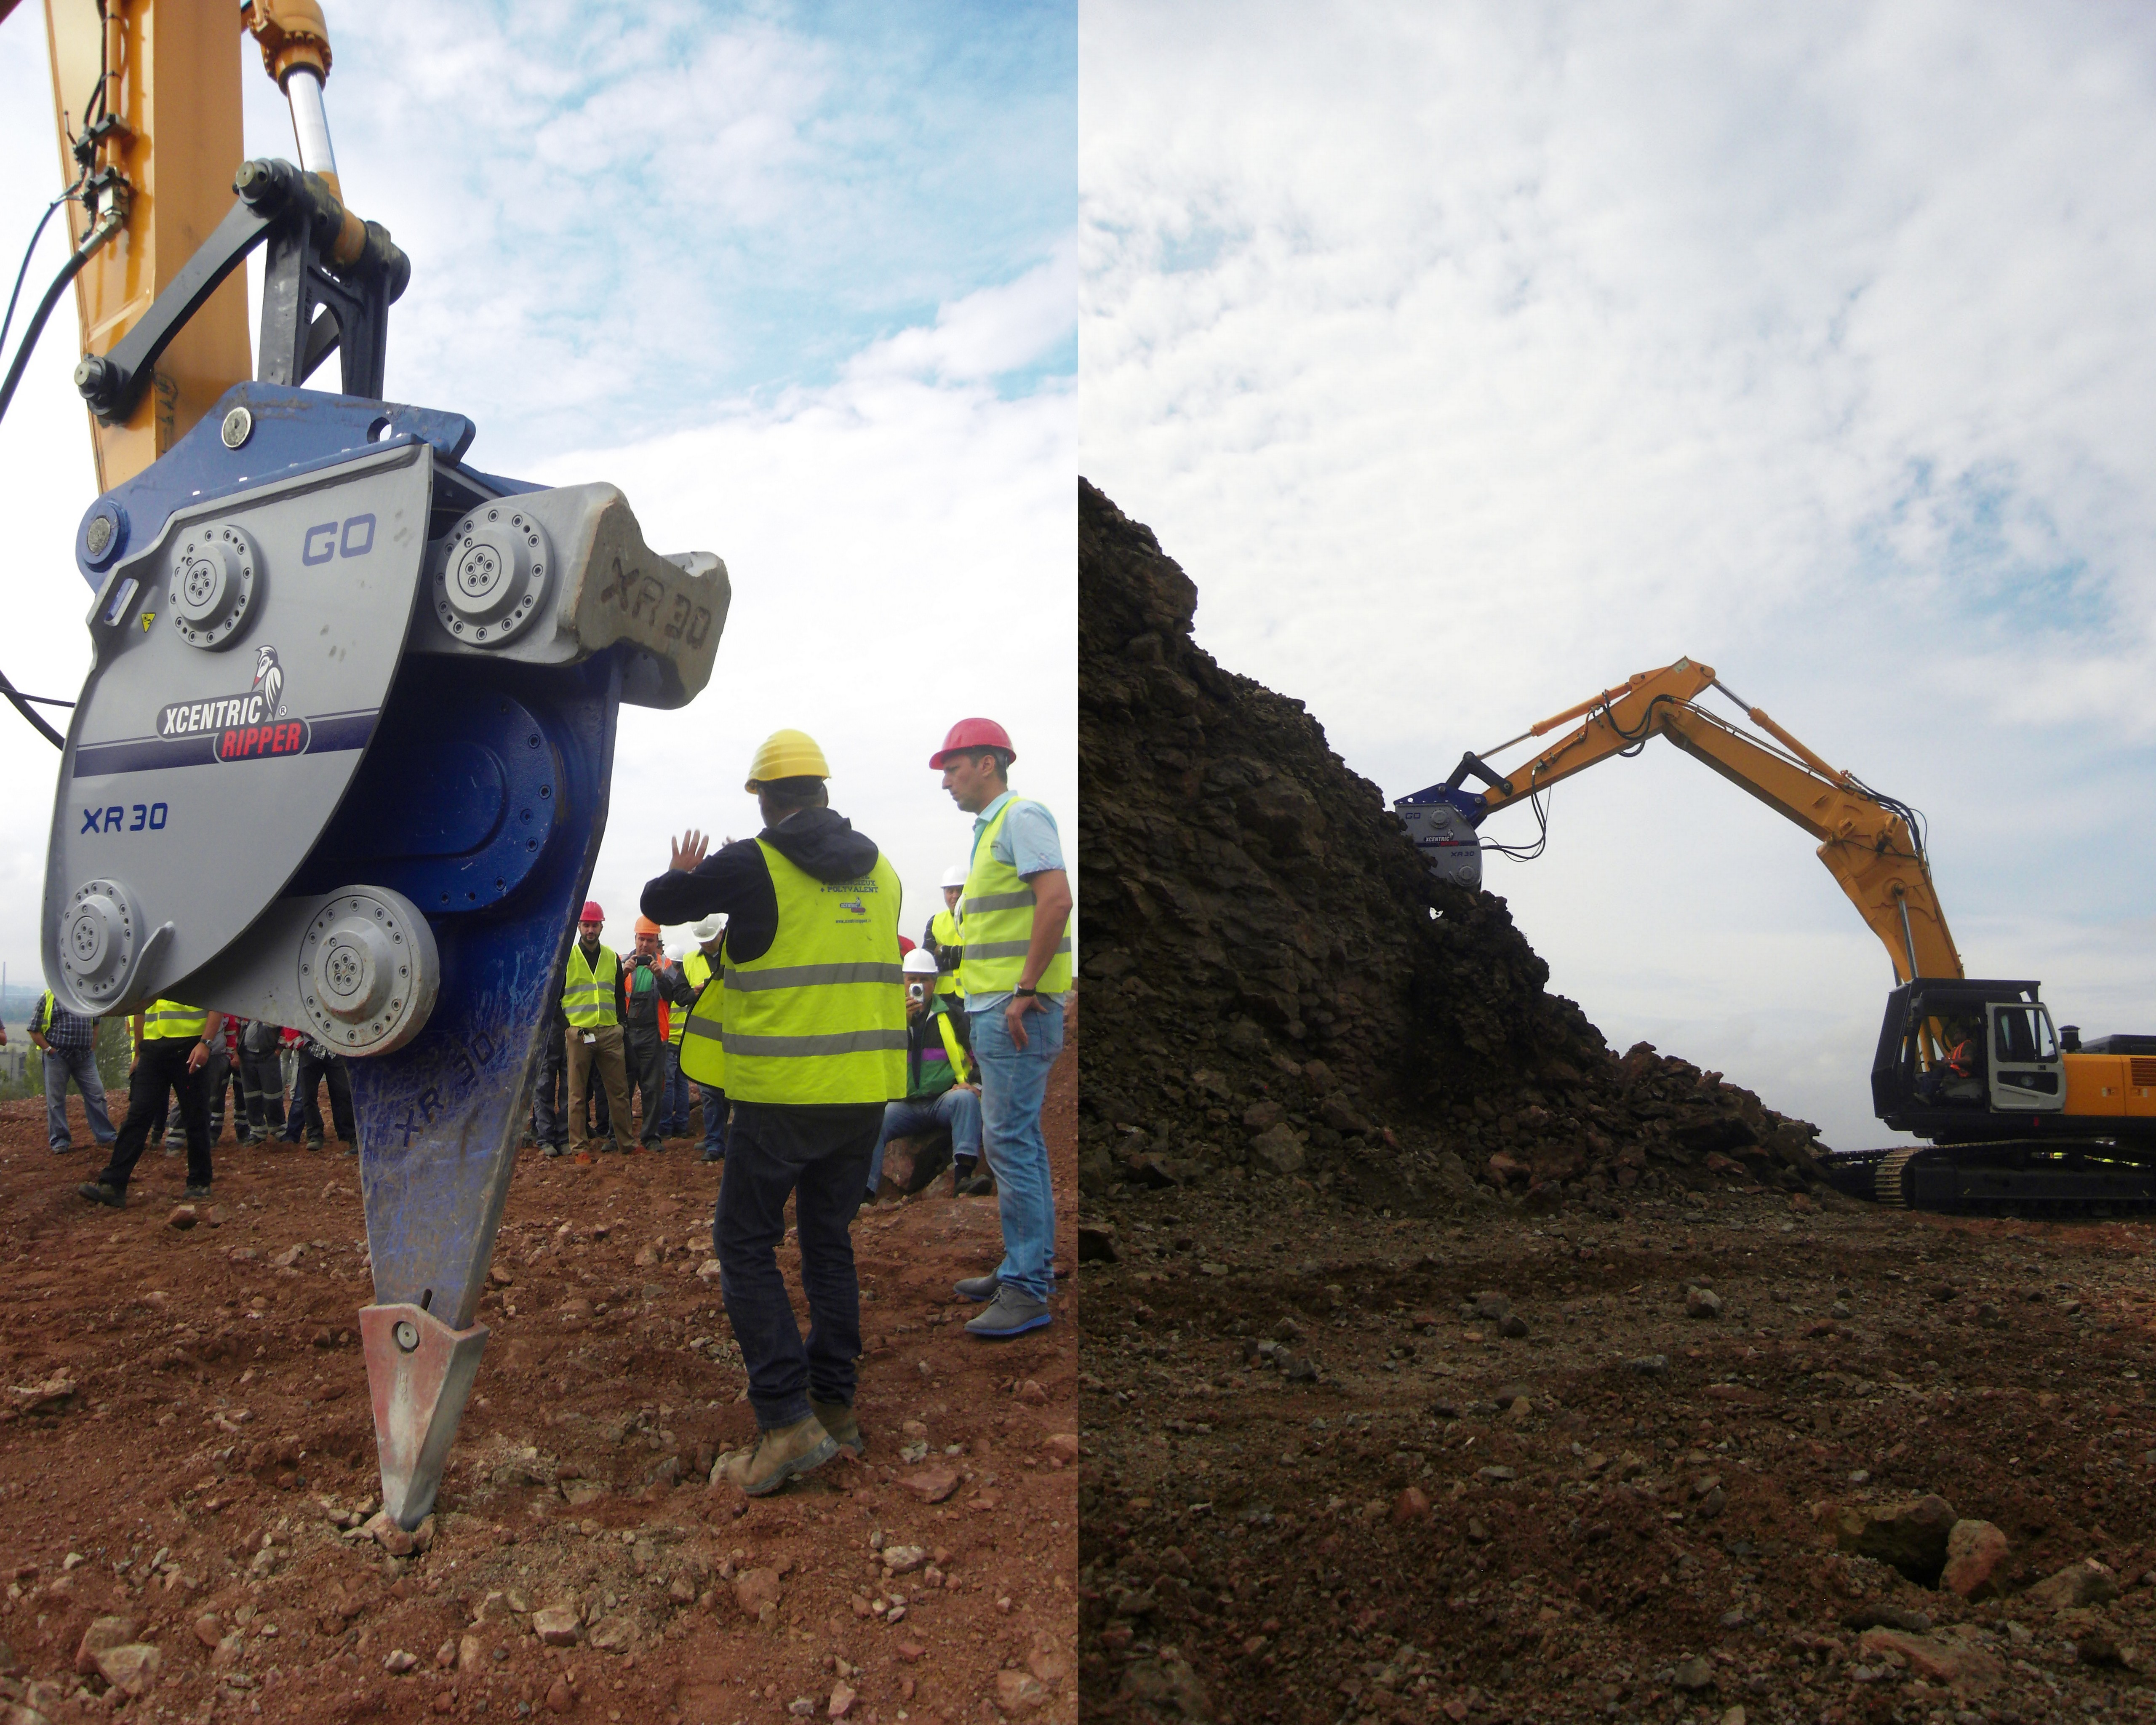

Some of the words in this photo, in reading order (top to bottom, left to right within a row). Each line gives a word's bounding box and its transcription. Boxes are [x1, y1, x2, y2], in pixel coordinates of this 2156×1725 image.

[302, 513, 376, 566] GO
[163, 695, 262, 735] XCENTRIC
[221, 722, 302, 758] RIPPER
